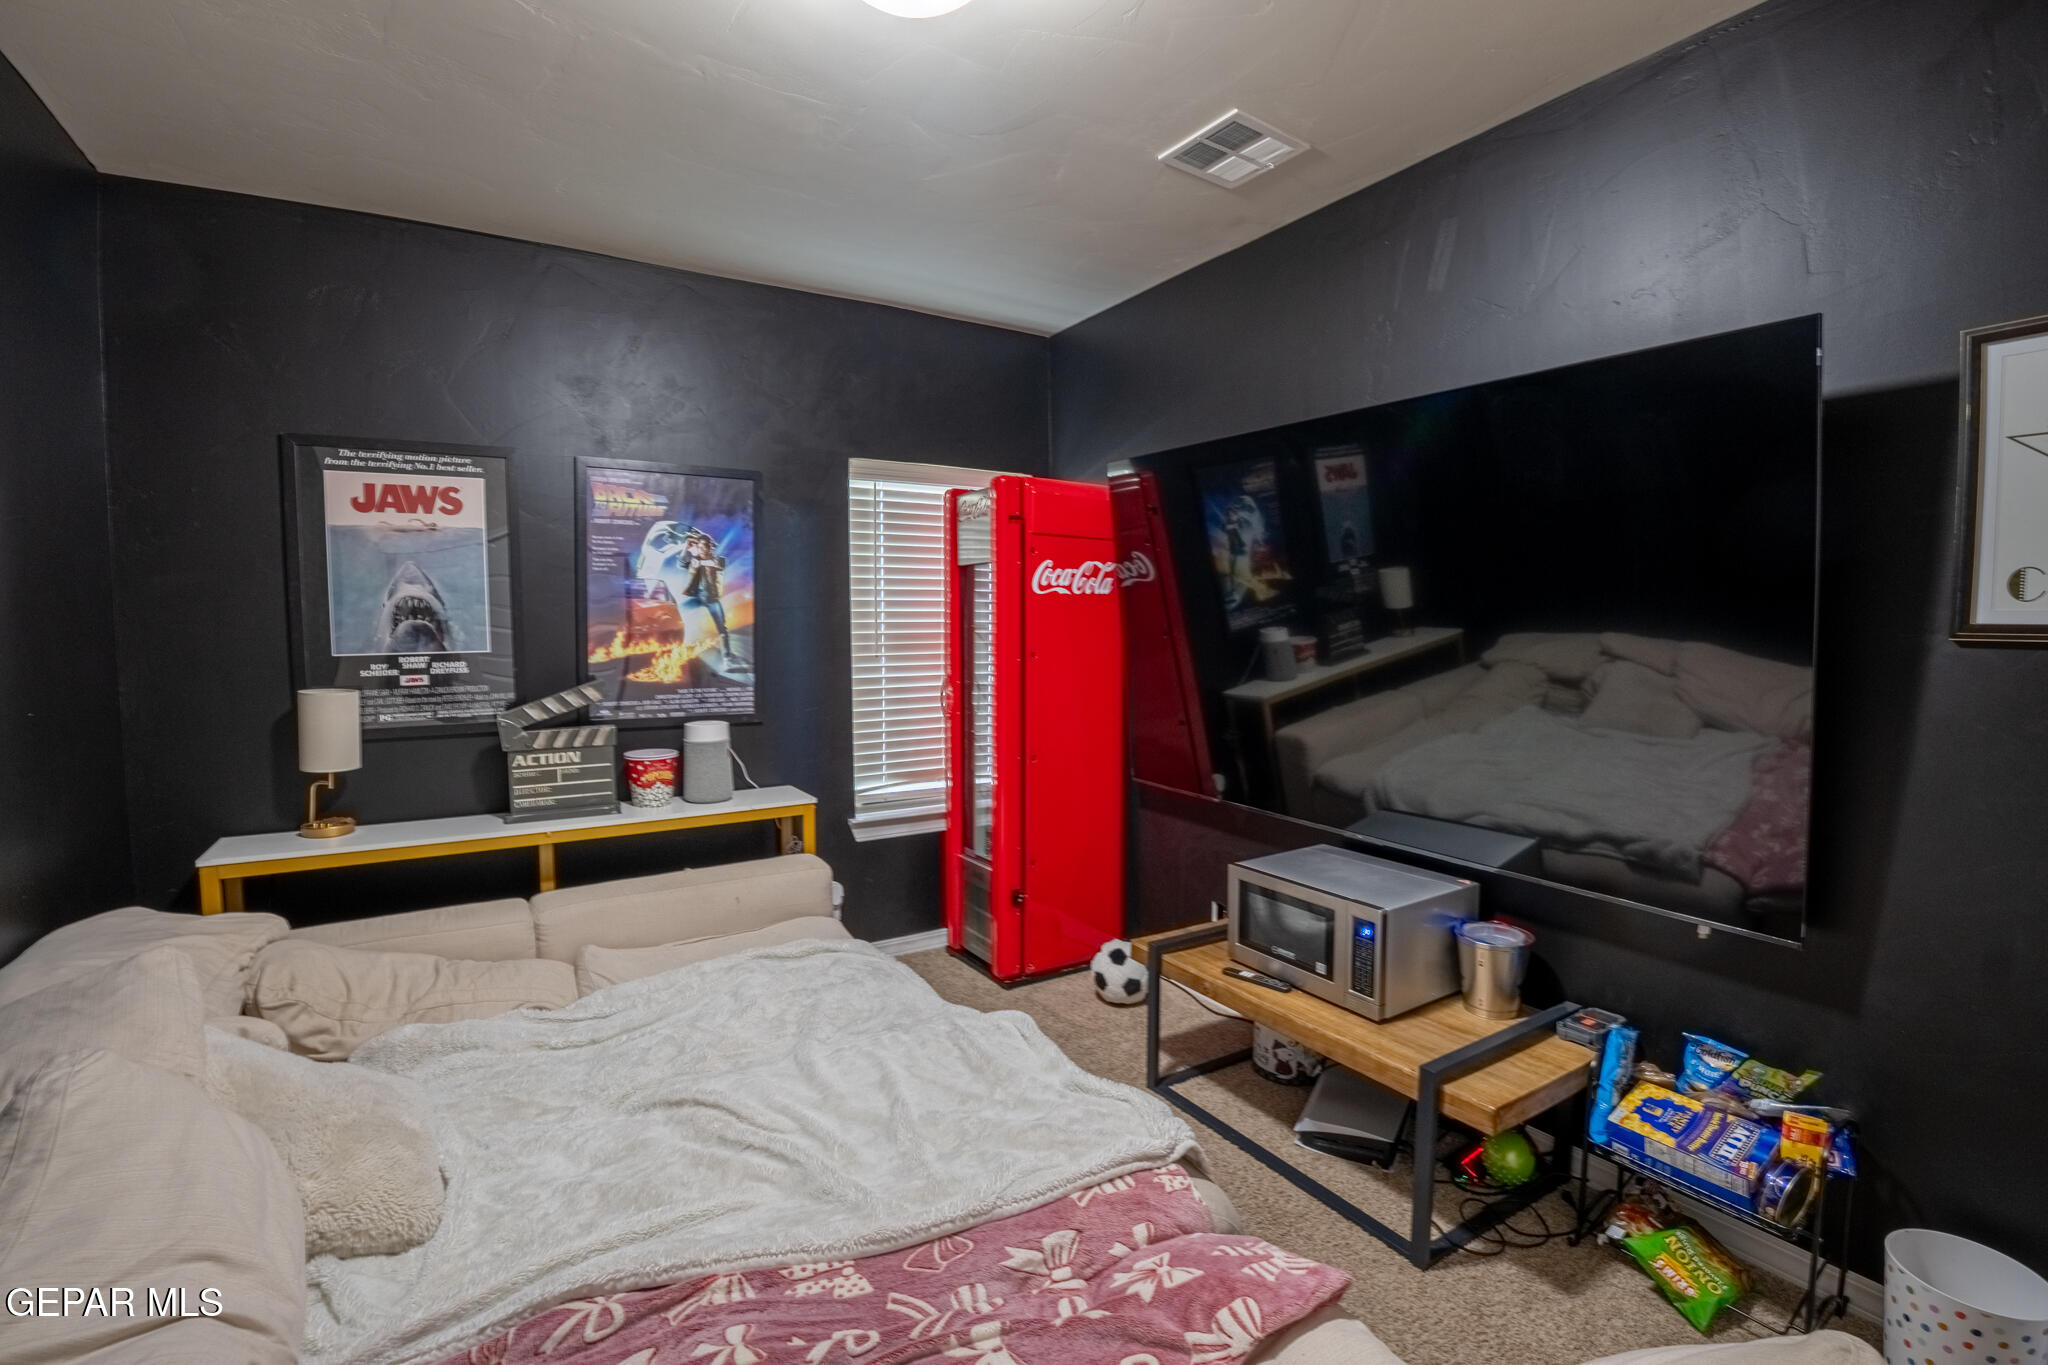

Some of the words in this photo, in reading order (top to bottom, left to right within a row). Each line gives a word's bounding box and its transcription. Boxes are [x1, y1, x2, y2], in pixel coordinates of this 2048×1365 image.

[324, 457, 349, 465] from
[367, 461, 413, 471] terrifying
[338, 448, 356, 457] The
[358, 451, 404, 461] terrifying
[438, 456, 472, 464] picture
[350, 482, 463, 515] JAWS
[1032, 560, 1115, 595] Coca-Cola
[511, 751, 582, 767] ACTION
[1695, 1041, 1738, 1065] Goldfish
[1664, 1235, 1722, 1295] ONION
